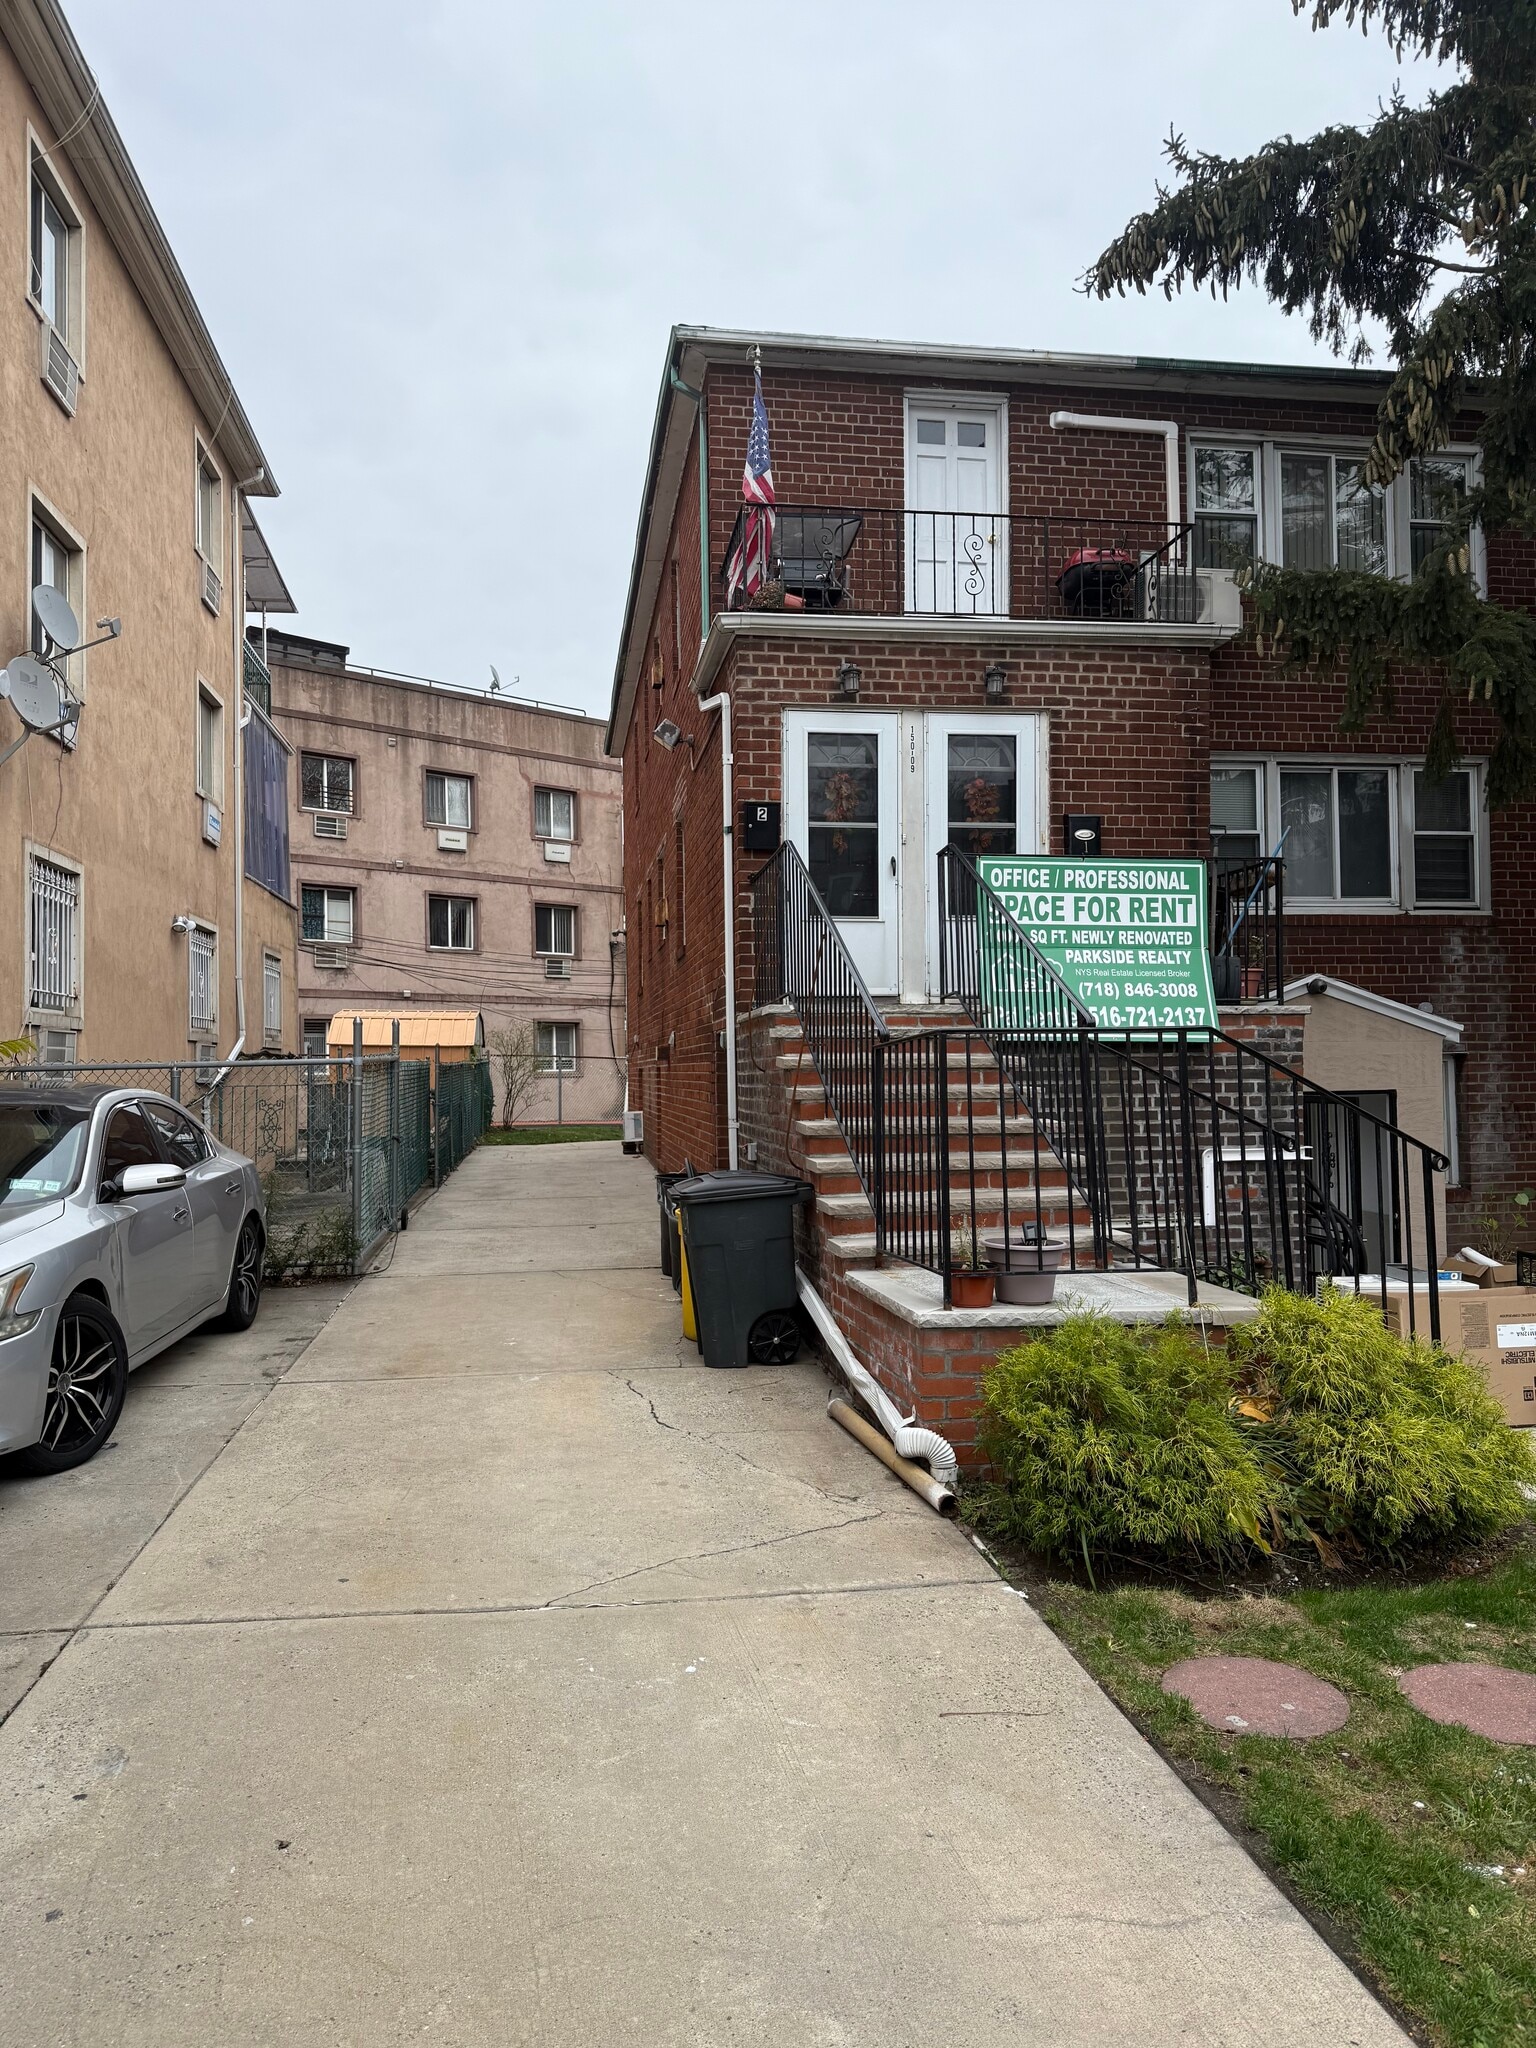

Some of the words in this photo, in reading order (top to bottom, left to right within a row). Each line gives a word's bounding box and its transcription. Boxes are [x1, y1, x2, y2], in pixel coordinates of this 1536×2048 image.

[758, 808, 766, 820] 2
[990, 868, 1050, 888] OFFICE
[1054, 868, 1060, 889] /
[1064, 869, 1190, 890] PROFESSIONAL
[1073, 896, 1121, 923] FOR
[1129, 897, 1193, 924] RENT
[1030, 929, 1048, 944] SQ
[1051, 930, 1068, 944] FT.
[1072, 930, 1115, 945] NEWLY
[1118, 930, 1193, 946] RENOVATED
[1065, 949, 1135, 964] PARKSIDE
[1138, 950, 1192, 965] REALTY
[1075, 968, 1092, 976] NYS
[1093, 969, 1110, 977] Real
[1111, 969, 1134, 977] Estate
[1134, 969, 1166, 977] Licensed
[1167, 969, 1191, 978] Broker
[1079, 982, 1120, 1000] (718)
[1124, 983, 1198, 998] 846-3008
[1088, 1006, 1206, 1027] 516-721-2137
